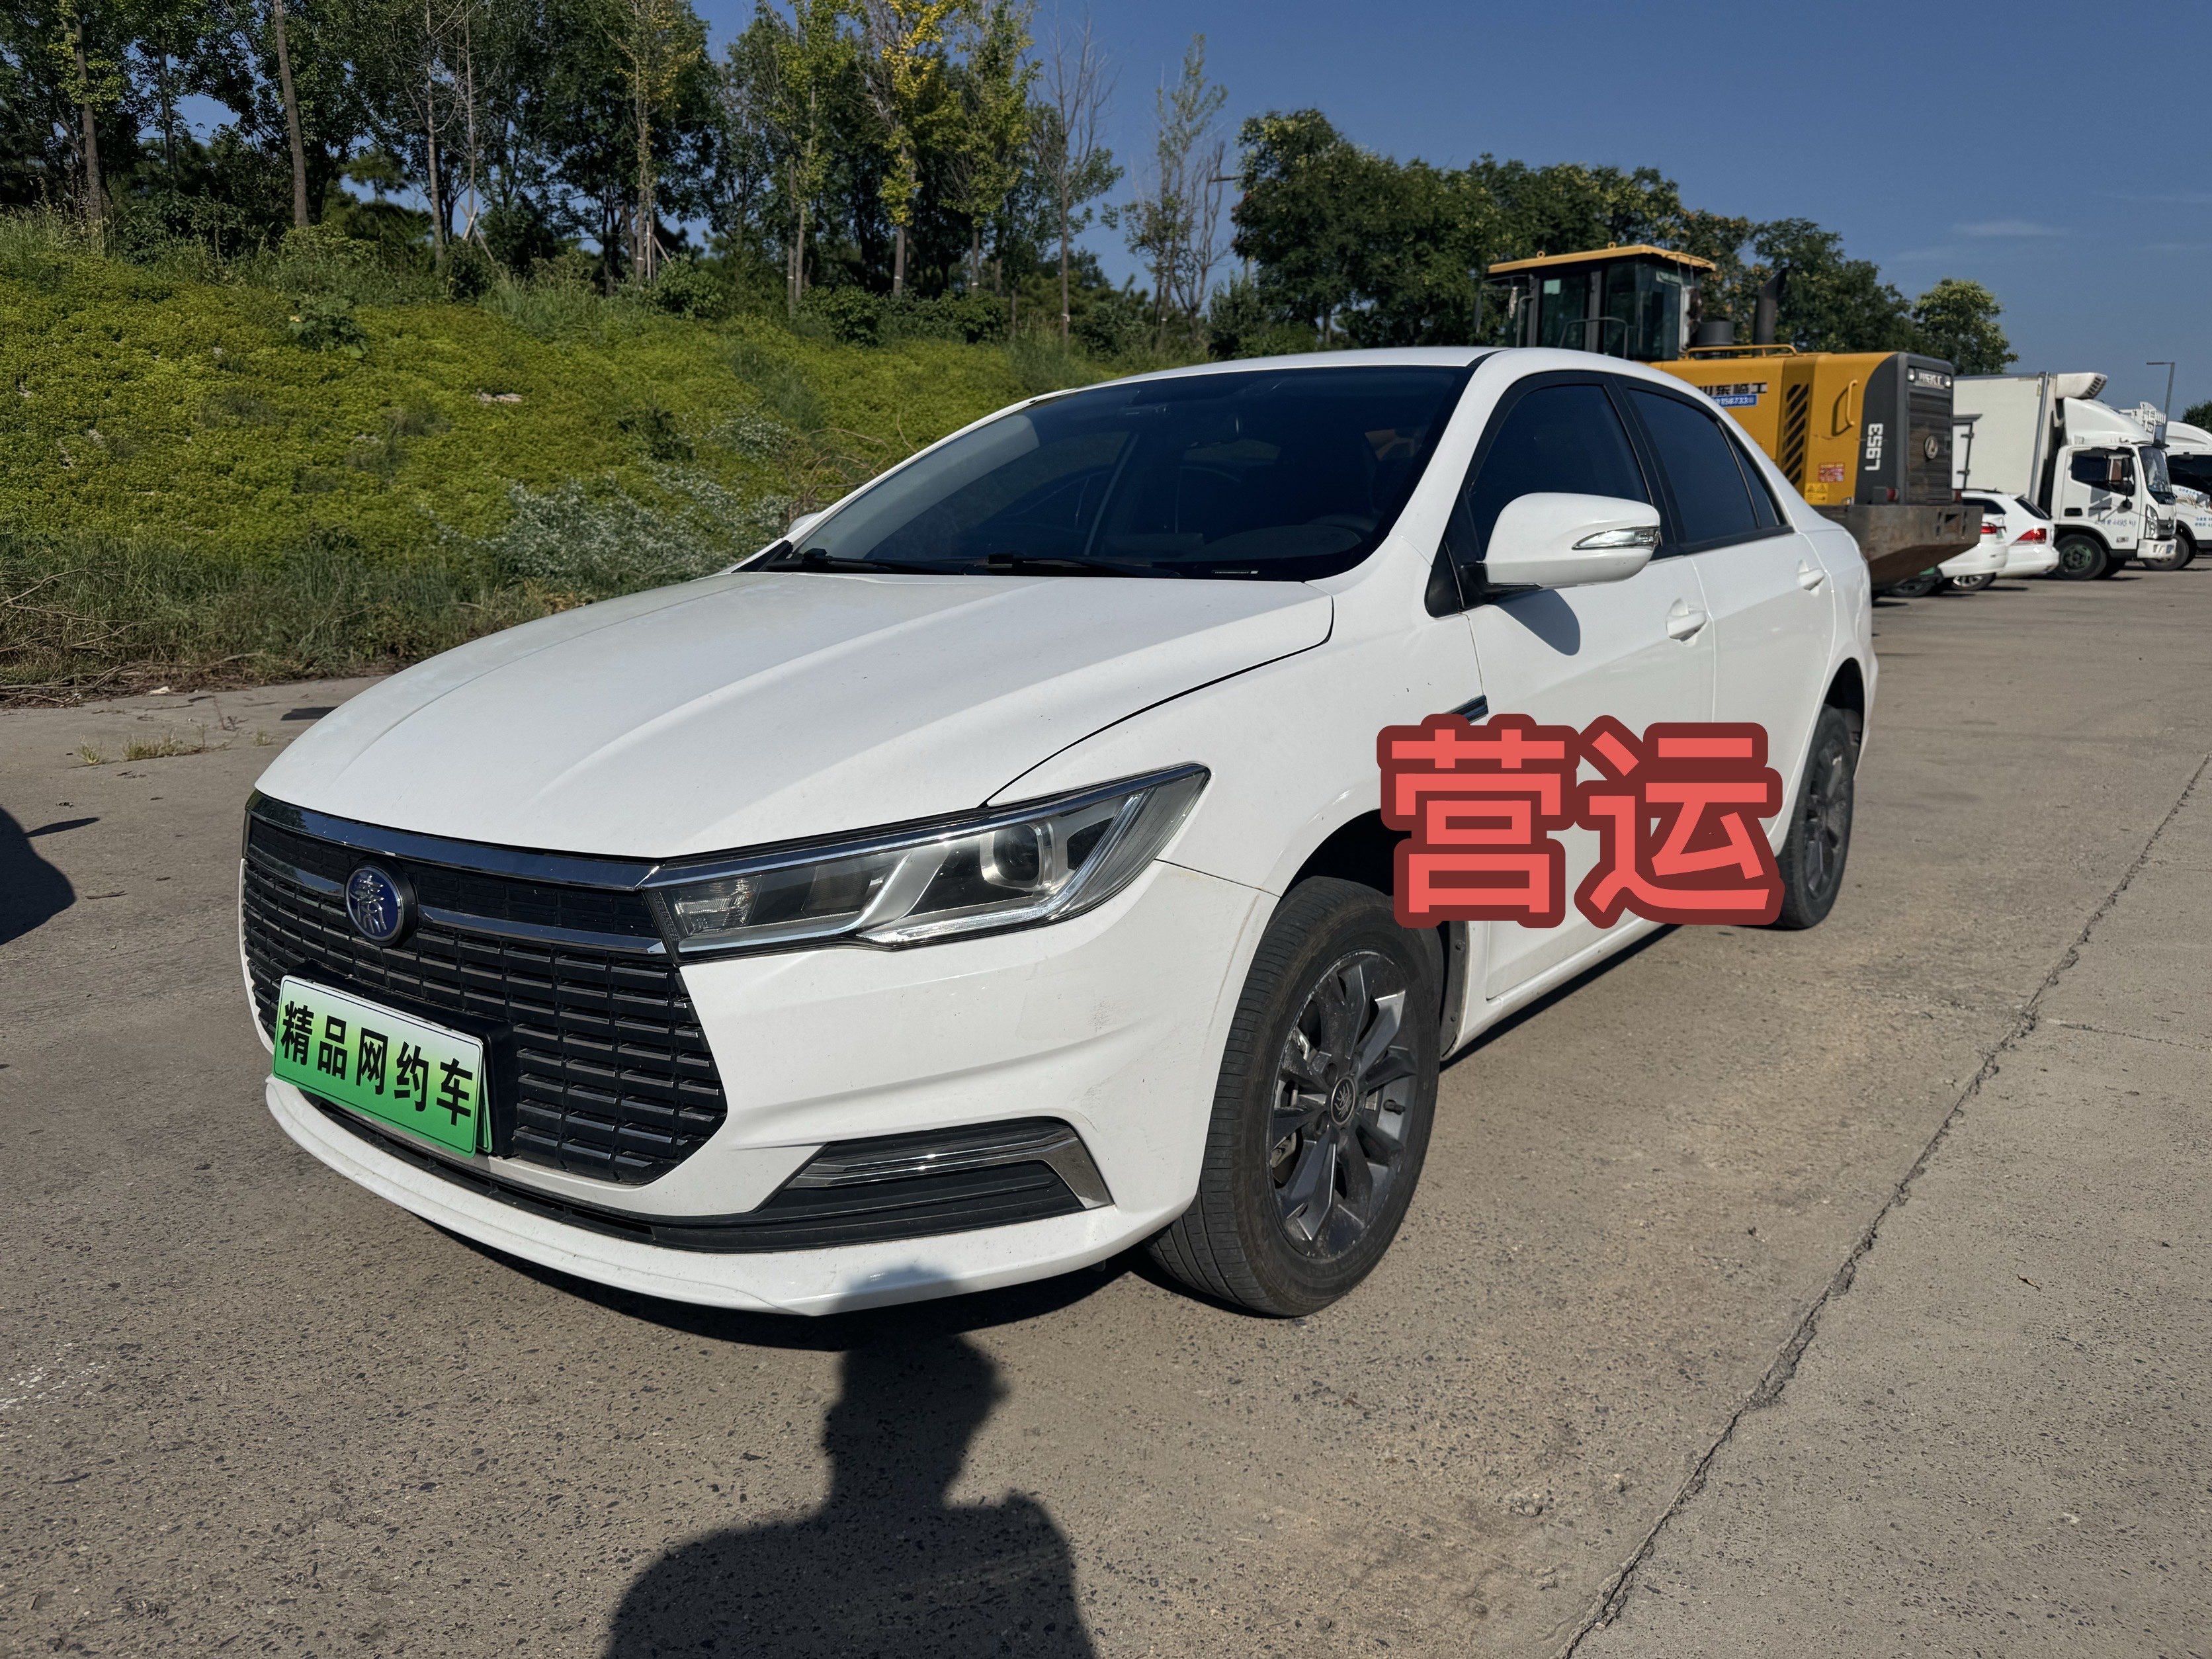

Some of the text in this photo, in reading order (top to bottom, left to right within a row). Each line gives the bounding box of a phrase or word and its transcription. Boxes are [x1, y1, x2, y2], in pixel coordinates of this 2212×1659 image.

[1865, 423, 1883, 471] L953
[280, 1000, 474, 1127] 精品网约车
